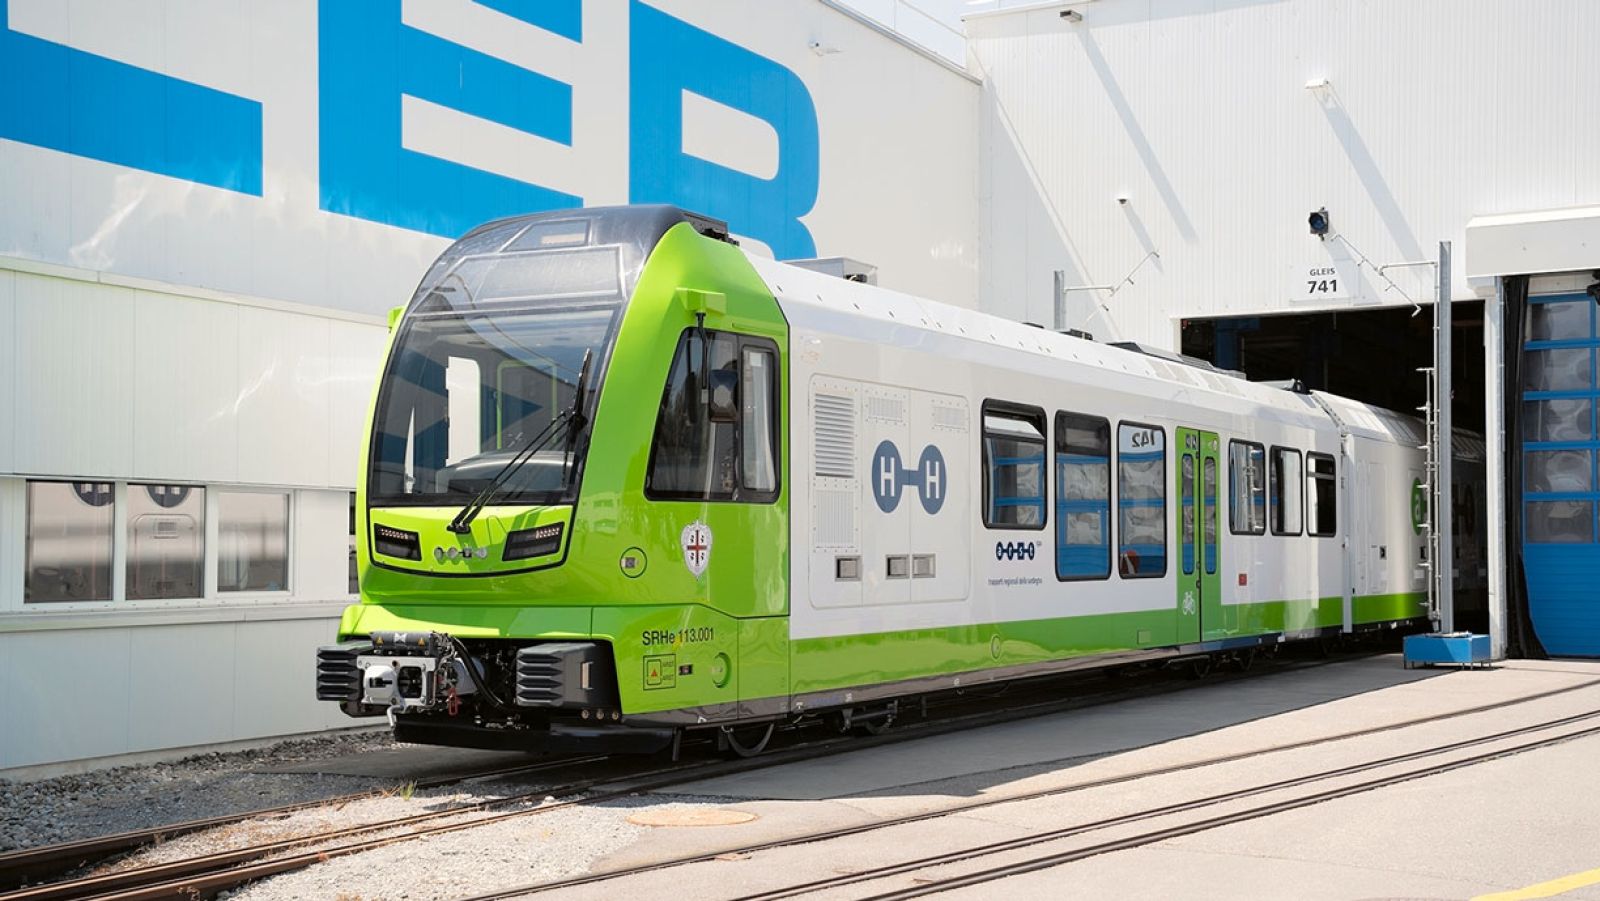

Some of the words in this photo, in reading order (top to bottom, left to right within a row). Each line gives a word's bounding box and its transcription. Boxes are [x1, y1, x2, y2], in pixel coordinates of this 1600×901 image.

[1309, 267, 1336, 276] GLEIS
[1307, 279, 1337, 294] 741
[642, 629, 675, 646] SRHe
[678, 627, 714, 643] 113.001
